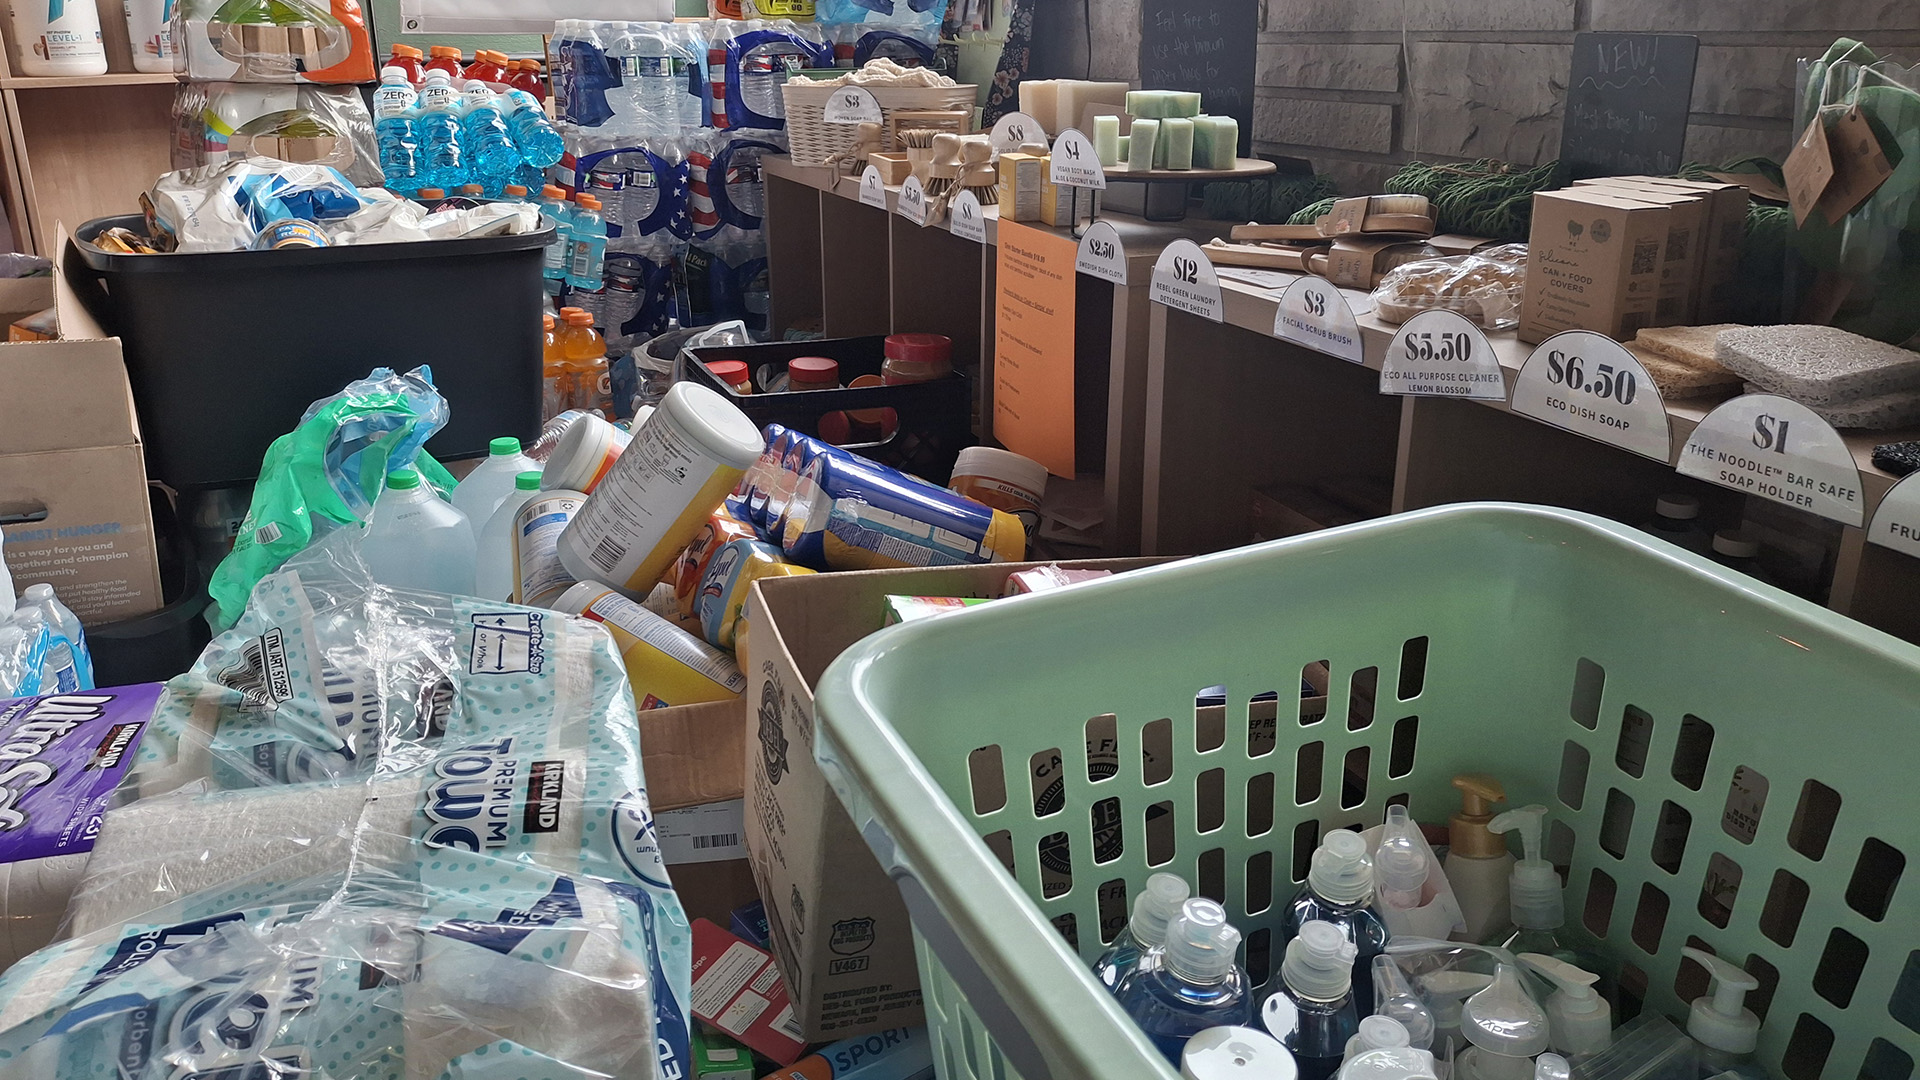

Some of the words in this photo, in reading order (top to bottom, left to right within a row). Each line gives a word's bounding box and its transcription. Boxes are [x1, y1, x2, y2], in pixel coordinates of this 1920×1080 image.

[1598, 37, 1658, 74] NEW!
[845, 94, 860, 109] $3
[1008, 125, 1024, 142] $8
[1065, 140, 1080, 160] $4
[1069, 176, 1089, 184] COCONUT
[1089, 178, 1100, 186] MILK
[1083, 168, 1096, 176] WASH
[1089, 238, 1115, 260] $2.50
[1078, 260, 1098, 272] SWEDISH
[1098, 266, 1108, 274] DISH
[1109, 268, 1124, 279] CLOTH
[1173, 255, 1198, 285] $12
[1543, 267, 1559, 277] CAN
[1569, 273, 1593, 285] FOOD
[1156, 282, 1172, 294] REBEL
[1172, 287, 1189, 298] GREEN
[1190, 292, 1217, 306] LAUNDRY
[1550, 279, 1585, 293] COVERS
[1160, 294, 1189, 310] DETERGENT
[1189, 304, 1211, 317] SHEETS
[1303, 288, 1325, 317] $3
[1282, 316, 1304, 330] FACIAL
[1305, 323, 1327, 338] SCRUB
[1328, 331, 1352, 346] BRUSH
[1404, 332, 1472, 362] $5.50
[1384, 371, 1400, 380] ECO
[1402, 371, 1417, 381] ALL
[1419, 371, 1456, 382] PURPOSE
[1458, 373, 1500, 383] CLEANER
[1546, 349, 1637, 406] $6.50
[1408, 384, 1434, 393] LEMON
[1435, 385, 1472, 395] BLOSSOM
[1546, 396, 1566, 411] ECO
[1569, 404, 1596, 421] DISH
[1599, 413, 1630, 431] SOAP
[1752, 412, 1789, 455] $1
[1689, 443, 1714, 460] THE
[1786, 472, 1814, 490] BAR
[1818, 482, 1856, 502] SAFE
[997, 484, 1014, 494] KILLS
[1719, 470, 1754, 489] SOAP
[1758, 482, 1813, 508] HOLDER
[57, 522, 121, 538] HUNGER
[8, 550, 17, 559] is
[28, 548, 51, 558] way
[54, 544, 70, 554] for
[71, 545, 91, 555] you
[93, 541, 114, 550] and
[54, 556, 75, 565] and
[76, 551, 129, 564] champion
[16, 567, 78, 580] community.
[60, 583, 74, 591] and
[480, 633, 487, 645] or
[100, 723, 140, 768] KIRKLAND
[58, 817, 77, 848] SHEETS
[834, 959, 864, 973] V467
[823, 986, 877, 1001] DISTRIBUTED
